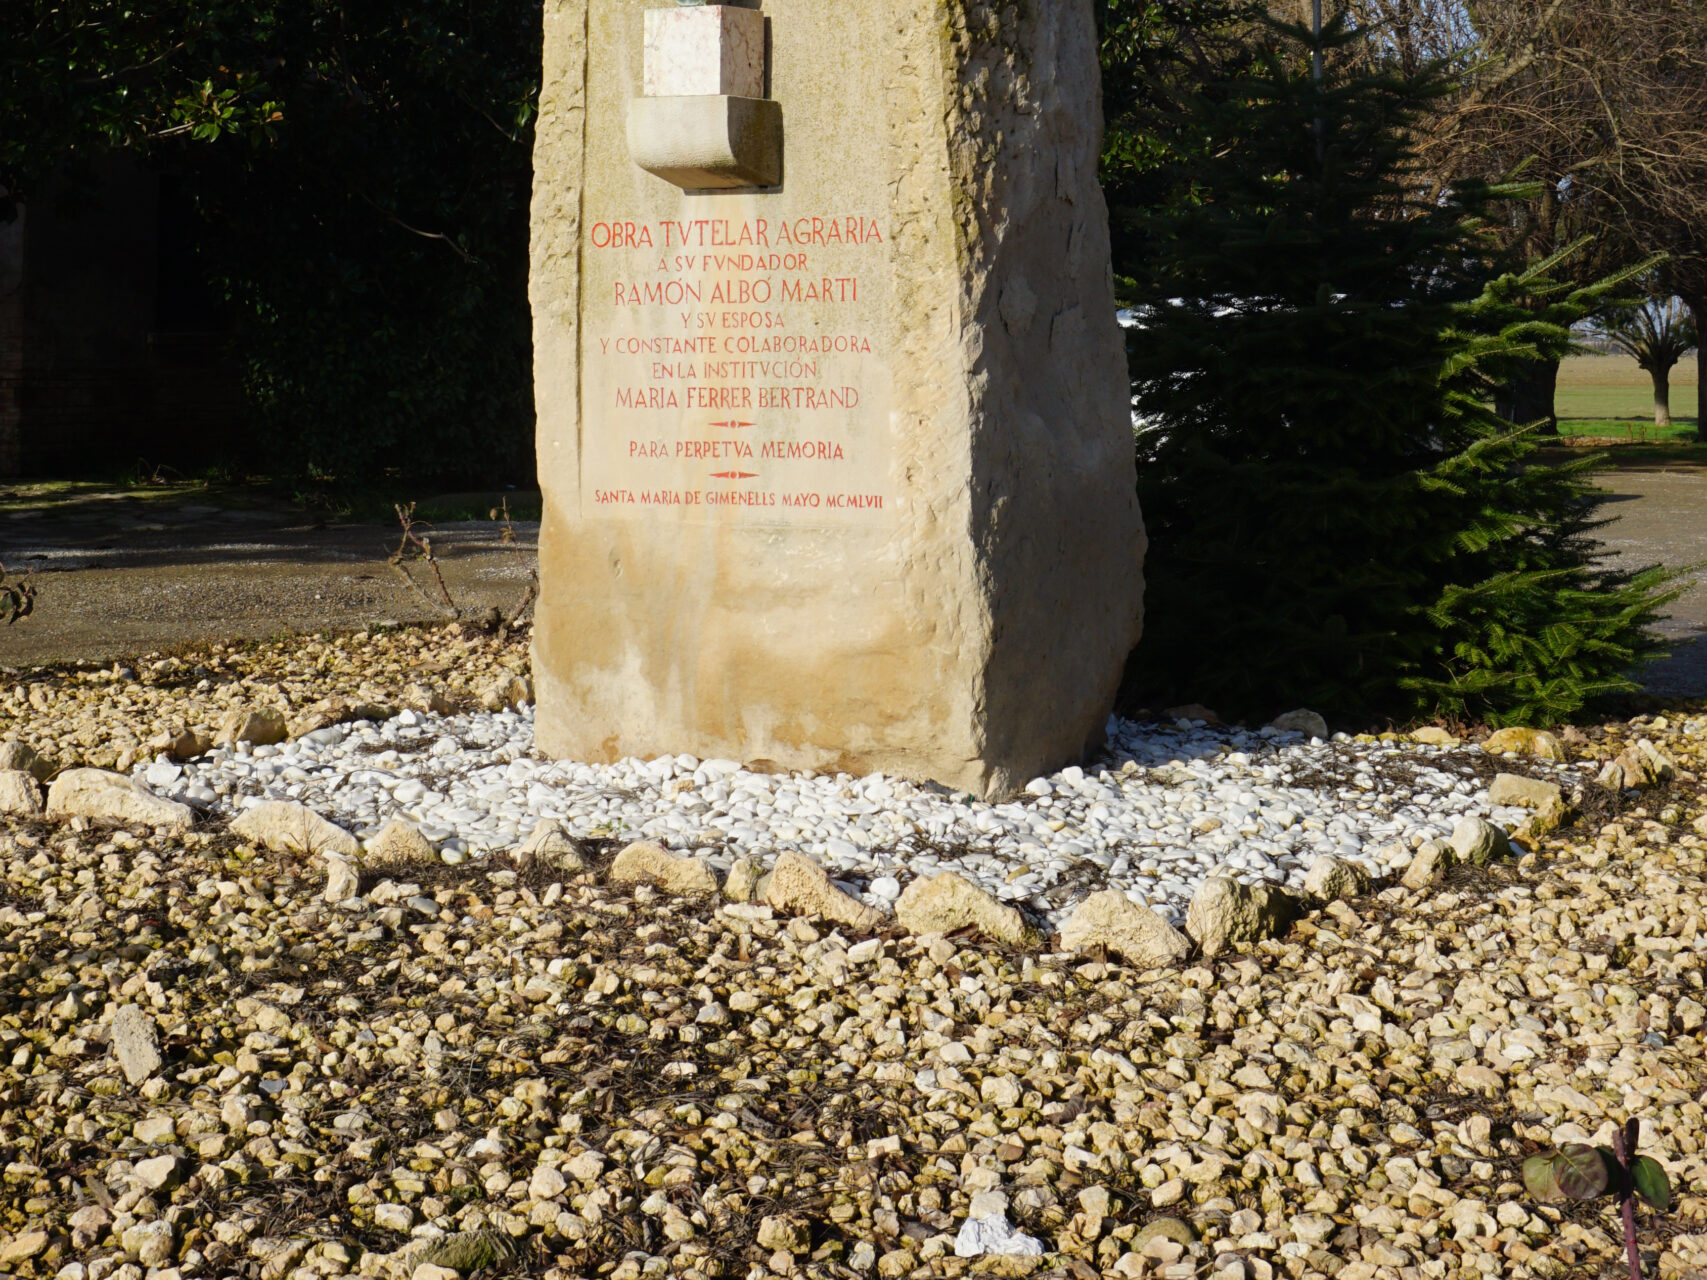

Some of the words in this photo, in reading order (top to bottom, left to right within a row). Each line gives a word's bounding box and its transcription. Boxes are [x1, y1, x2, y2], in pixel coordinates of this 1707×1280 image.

[591, 222, 653, 249] OBRA
[659, 219, 769, 248] TVTELAR
[776, 216, 883, 246] AGRARIA
[657, 258, 669, 272] A
[675, 255, 695, 271] SV
[703, 253, 808, 271] FVNDADOR
[614, 277, 701, 306] RAMÓN
[710, 276, 771, 304] ALBÓ
[781, 277, 857, 303] MARTI
[680, 312, 691, 329] Y
[697, 312, 716, 328] SV
[722, 312, 785, 329] ESPOSA
[600, 337, 610, 354] Y
[616, 337, 715, 354] CONSTANTE
[724, 335, 871, 354] COLABORADORA
[653, 362, 674, 379] EN
[677, 362, 696, 379] LA
[704, 358, 816, 379] INSTITVCIÓN
[615, 387, 678, 408] MARIA
[687, 386, 752, 409] FERRER
[759, 386, 859, 409] BERTRAND
[629, 440, 669, 459] PARA
[676, 441, 754, 459] PERPETVA
[761, 441, 844, 459] MEMORIA
[595, 489, 635, 505] SANTA
[640, 491, 680, 505] MARIA
[685, 491, 701, 505] DE
[705, 490, 775, 506] GIMENELLS
[781, 493, 820, 507] MAYO
[826, 493, 883, 509] MCMLVII
